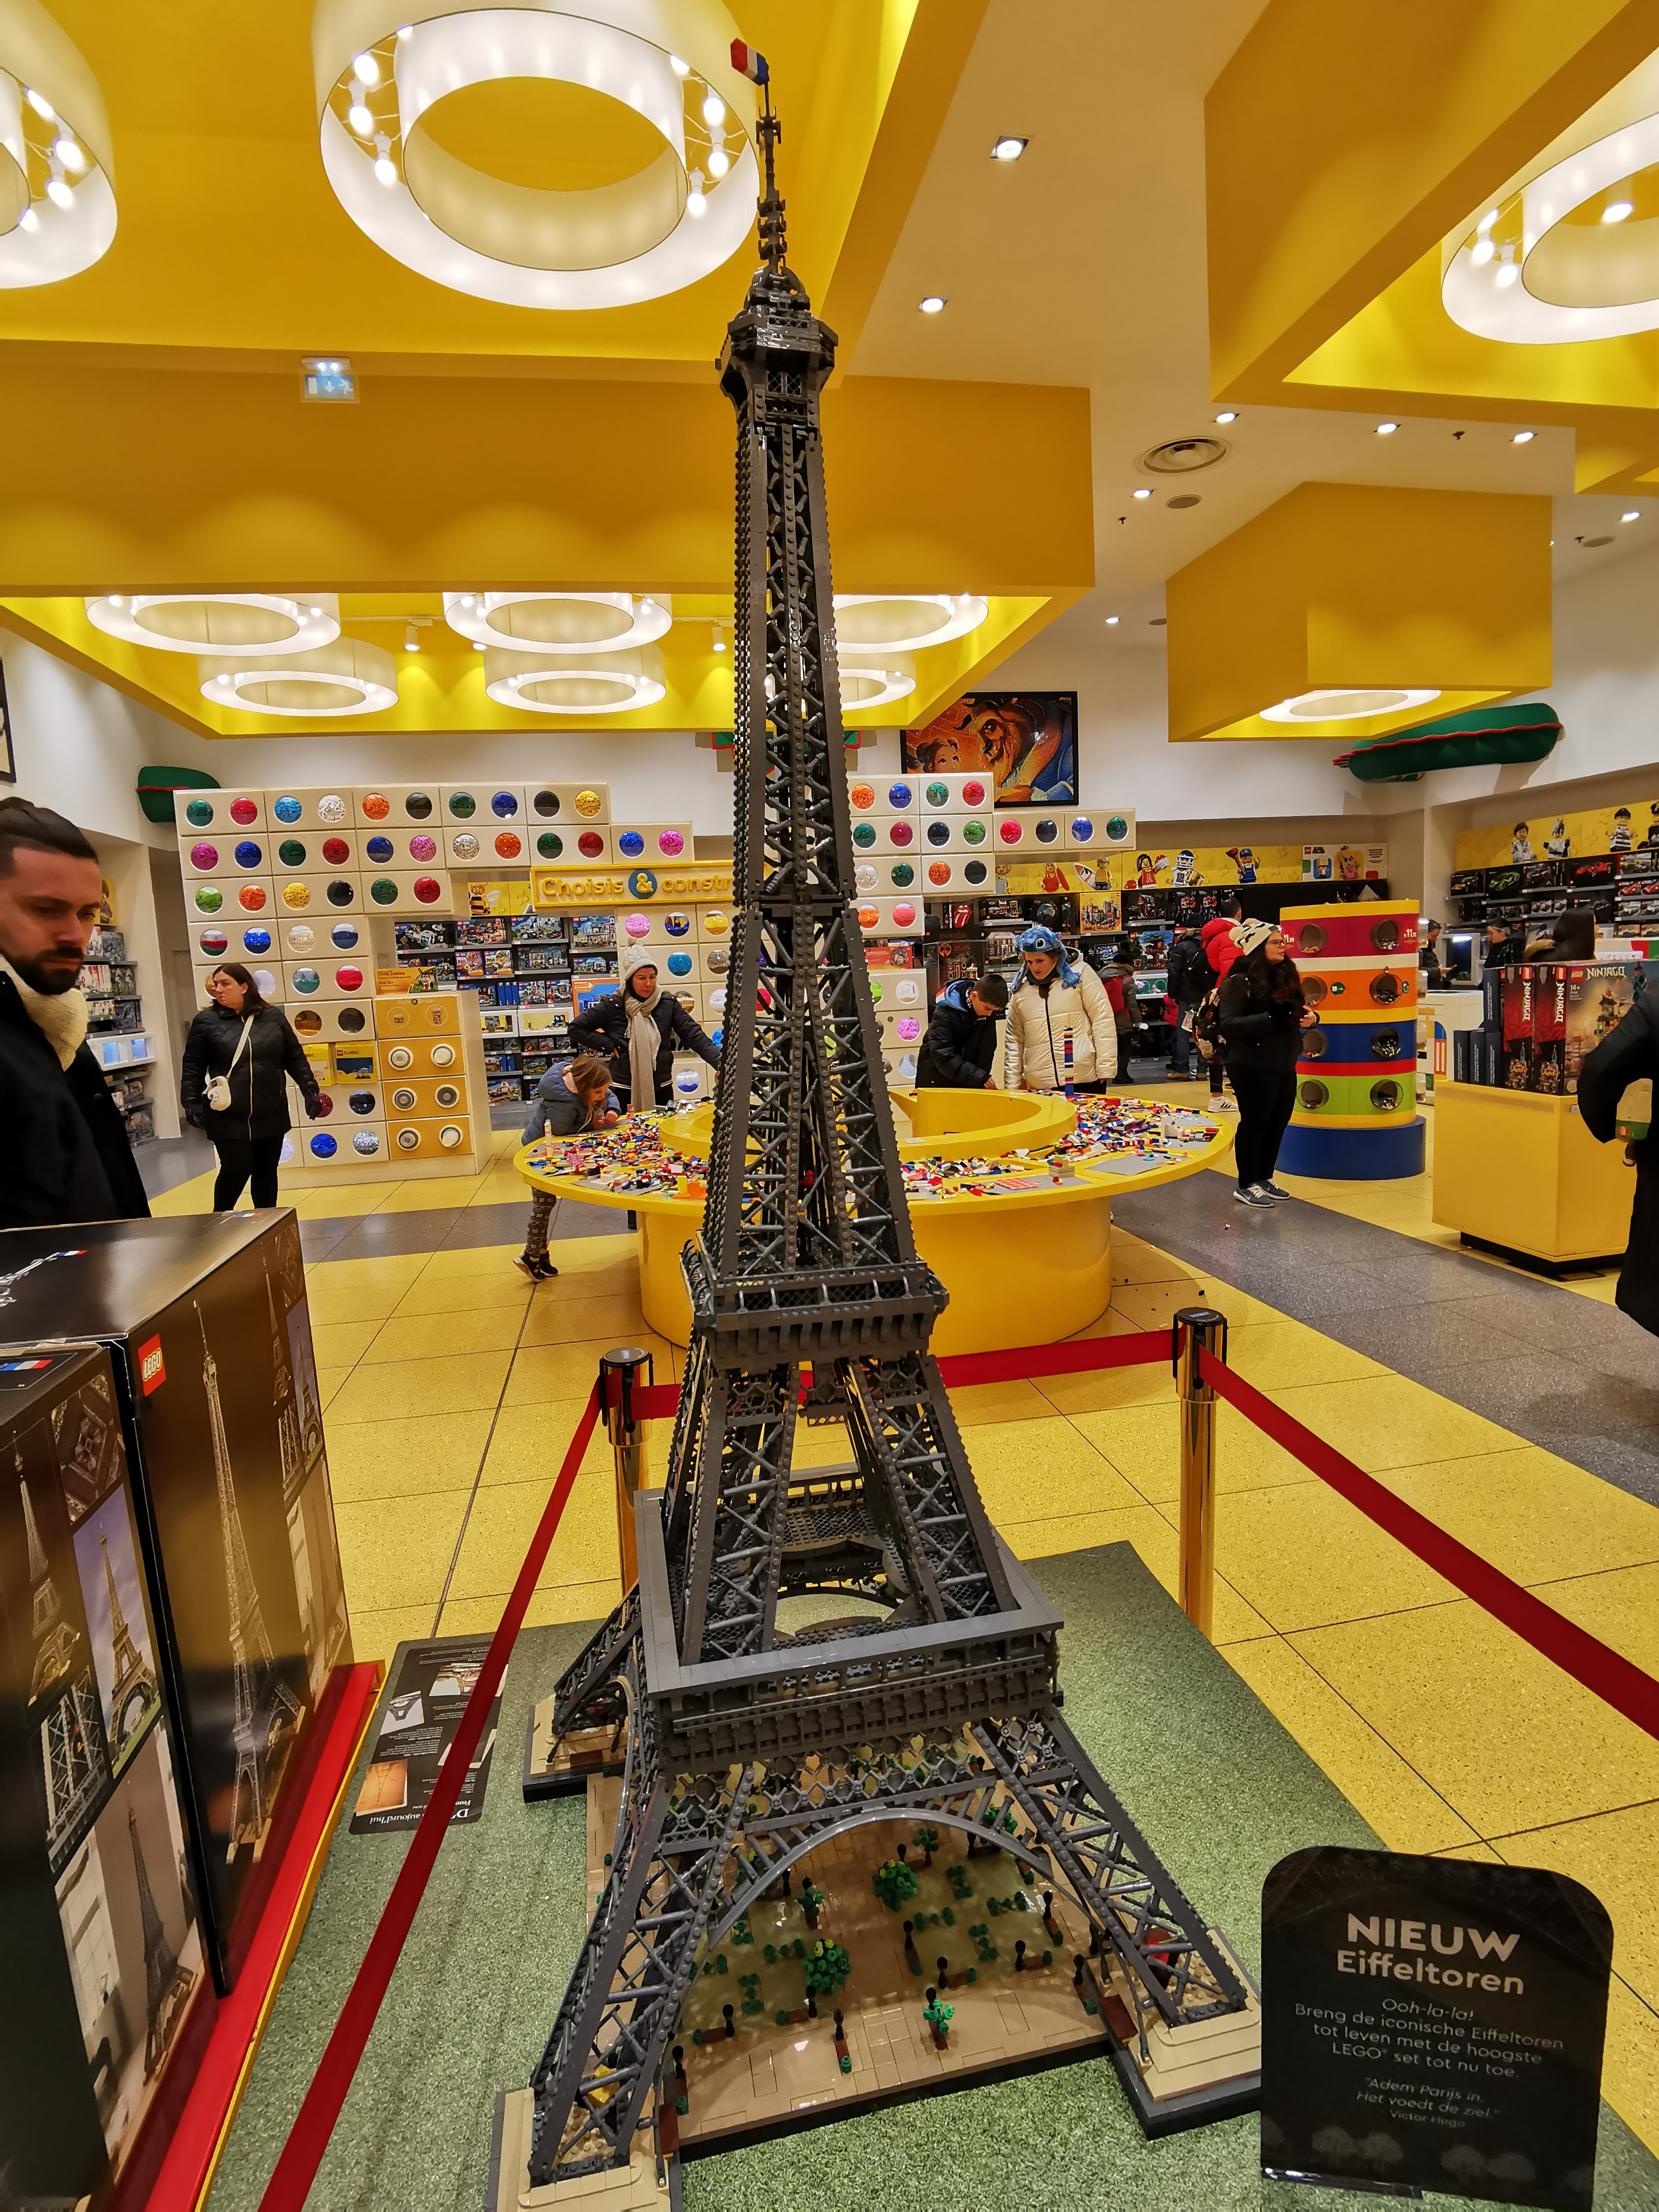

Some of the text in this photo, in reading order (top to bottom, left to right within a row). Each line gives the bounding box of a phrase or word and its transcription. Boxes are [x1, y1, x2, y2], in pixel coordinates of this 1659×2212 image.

[541, 877, 625, 896] Choisis
[636, 873, 654, 894] &
[1585, 965, 1628, 981] NINJAGO
[1522, 981, 1531, 1022] NINJAGO
[1553, 981, 1565, 1024] NINJAGO
[142, 1347, 163, 1382] LEGO
[369, 1812, 421, 1825] aujourd'hui
[1348, 1913, 1521, 1962] NIEUW
[1337, 1949, 1524, 1995] Eiffeltoren
[1382, 1998, 1474, 2021] Ooh-la-la!
[1296, 2003, 1563, 2050] Breng de iconische Eiffeltoren
[1314, 2023, 1542, 2064] tot leven met de hoogste
[1393, 2053, 1419, 2064] set
[1426, 2056, 1451, 2069] tot
[1457, 2061, 1479, 2072] nu
[1486, 2064, 1519, 2078] toe.
[1356, 2090, 1383, 2104] Het
[1389, 2097, 1434, 2110] voedt
[1438, 2101, 1459, 2114] de
[1419, 2084, 1462, 2101] Parijs
[1389, 2109, 1465, 2128] Victor Hugo
